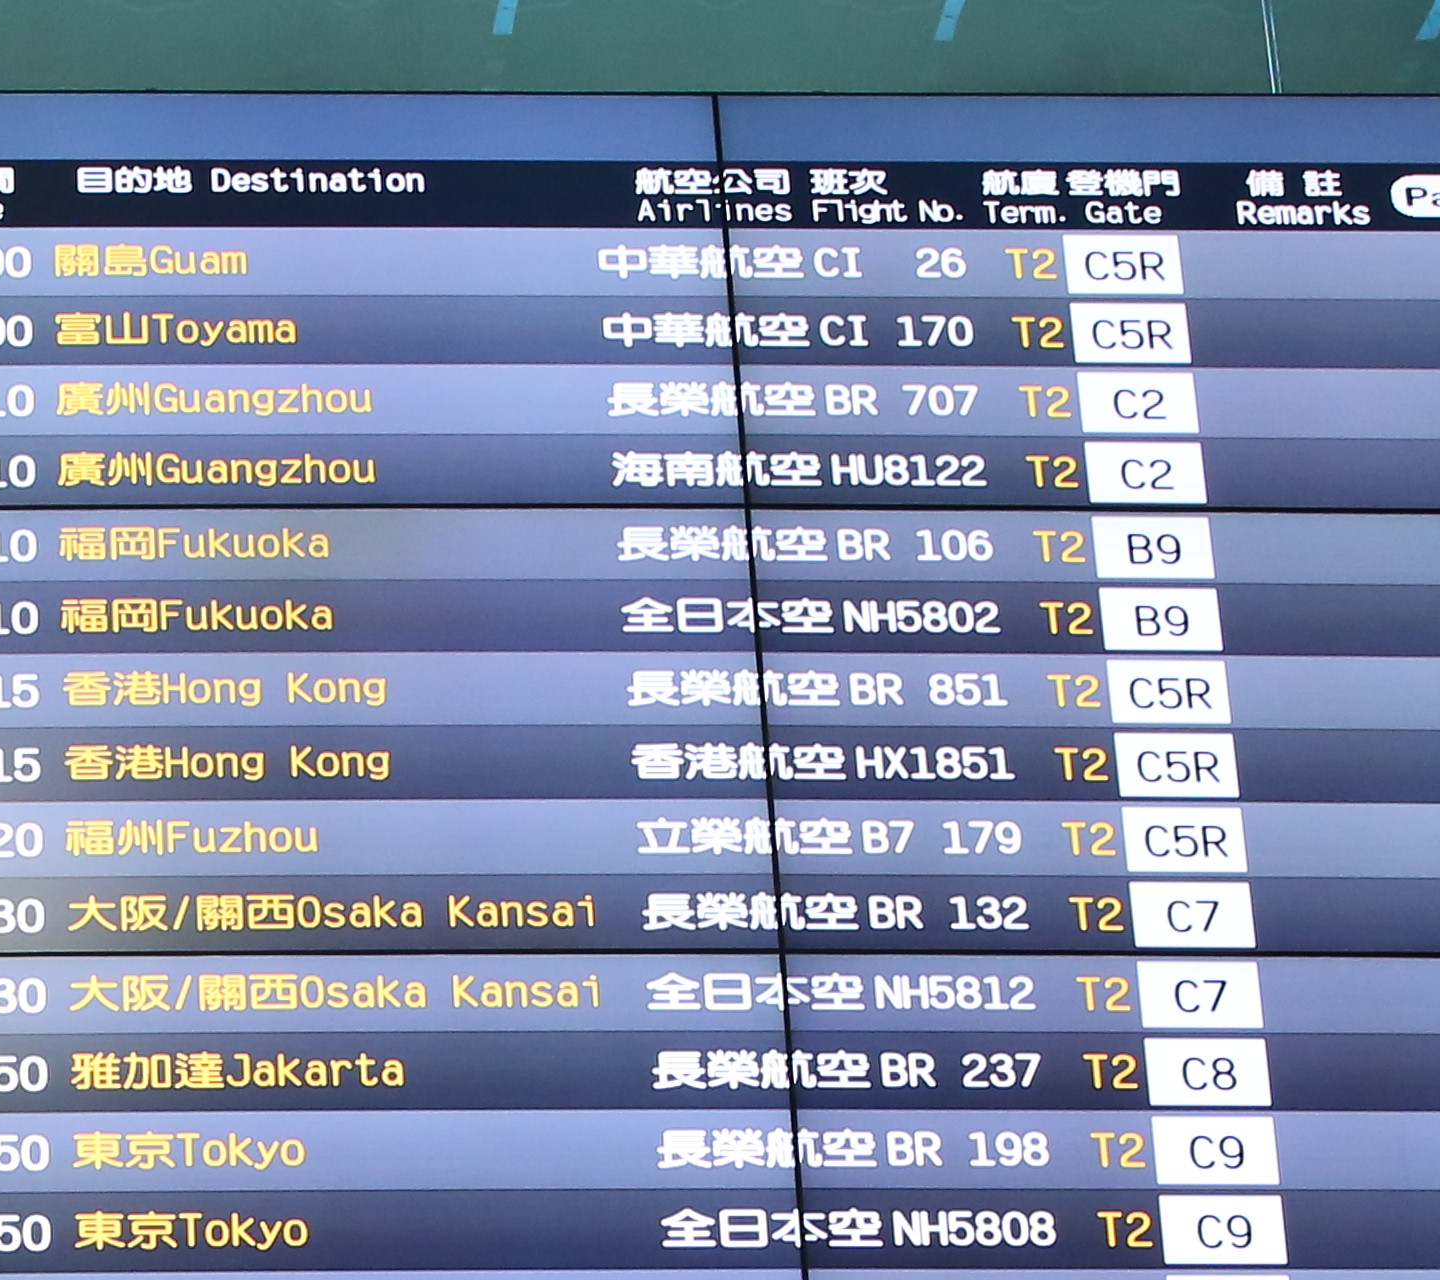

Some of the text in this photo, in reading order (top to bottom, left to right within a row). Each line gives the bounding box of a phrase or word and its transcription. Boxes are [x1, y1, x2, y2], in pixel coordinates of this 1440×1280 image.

[602, 311, 811, 348] 中華航空
[819, 315, 869, 347] CI
[896, 315, 974, 347] 170
[1011, 316, 1064, 348] T2
[1092, 319, 1173, 350] C5R
[452, 974, 599, 1008] Kansai
[645, 971, 865, 1011] 全日本空
[874, 974, 1037, 1010] NH5812
[1075, 976, 1131, 1011] T2
[1174, 979, 1227, 1013] C7
